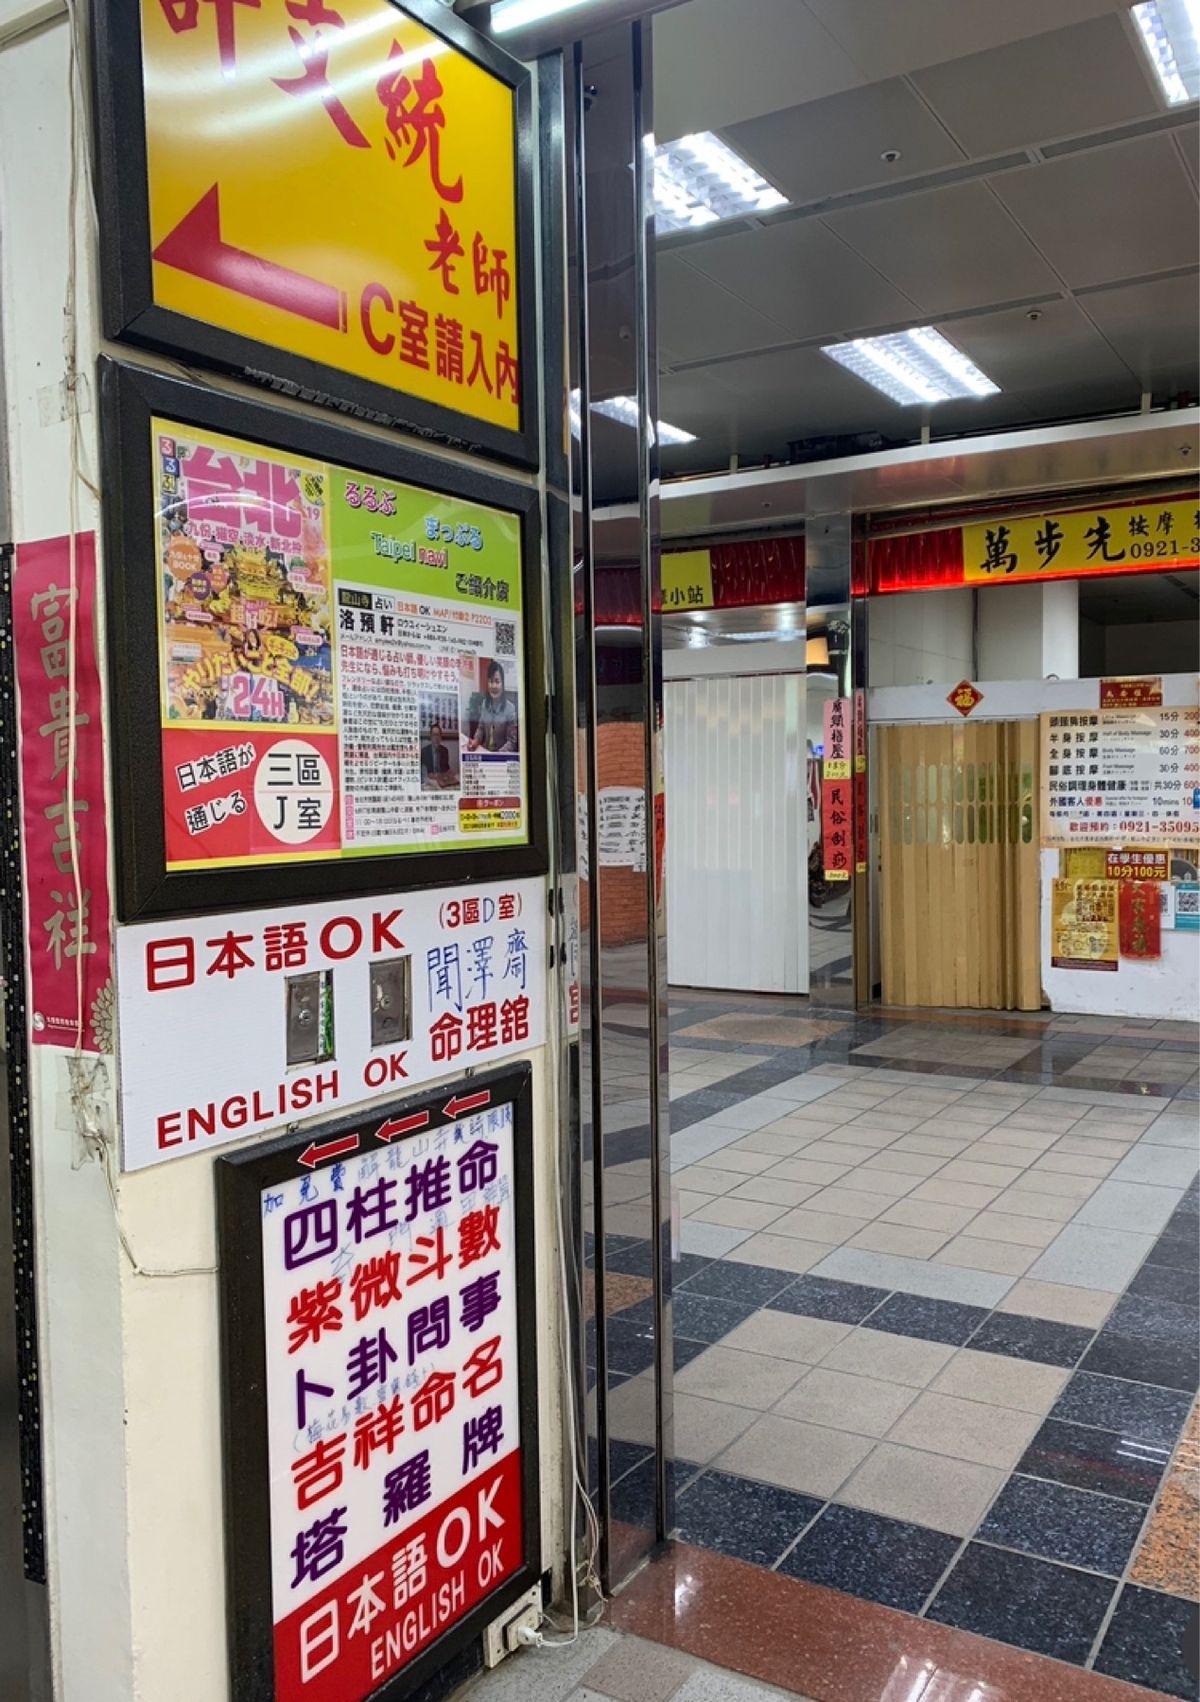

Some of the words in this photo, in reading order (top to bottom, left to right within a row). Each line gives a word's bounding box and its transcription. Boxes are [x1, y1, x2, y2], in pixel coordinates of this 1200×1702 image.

[424, 208, 510, 319] 老師
[371, 531, 416, 563] Taipei
[980, 516, 1126, 574] 萬步先
[31, 584, 97, 971] 富貴吉祥
[177, 745, 254, 790] 日本語が
[187, 791, 246, 834] 通じる
[267, 753, 321, 787] 三區
[273, 797, 322, 830] J室
[156, 1071, 339, 1150] ENGLISH
[364, 1051, 408, 1088] OK
[283, 1139, 500, 1271] 四柱推命
[286, 1203, 501, 1356] 紫微斗數
[294, 1270, 501, 1430] 卜卦問事
[290, 1335, 503, 1512] 吉祥命名
[290, 1404, 505, 1590] 塔羅牌
[370, 1570, 466, 1681] ENGLISH
[477, 1537, 505, 1588] OK
